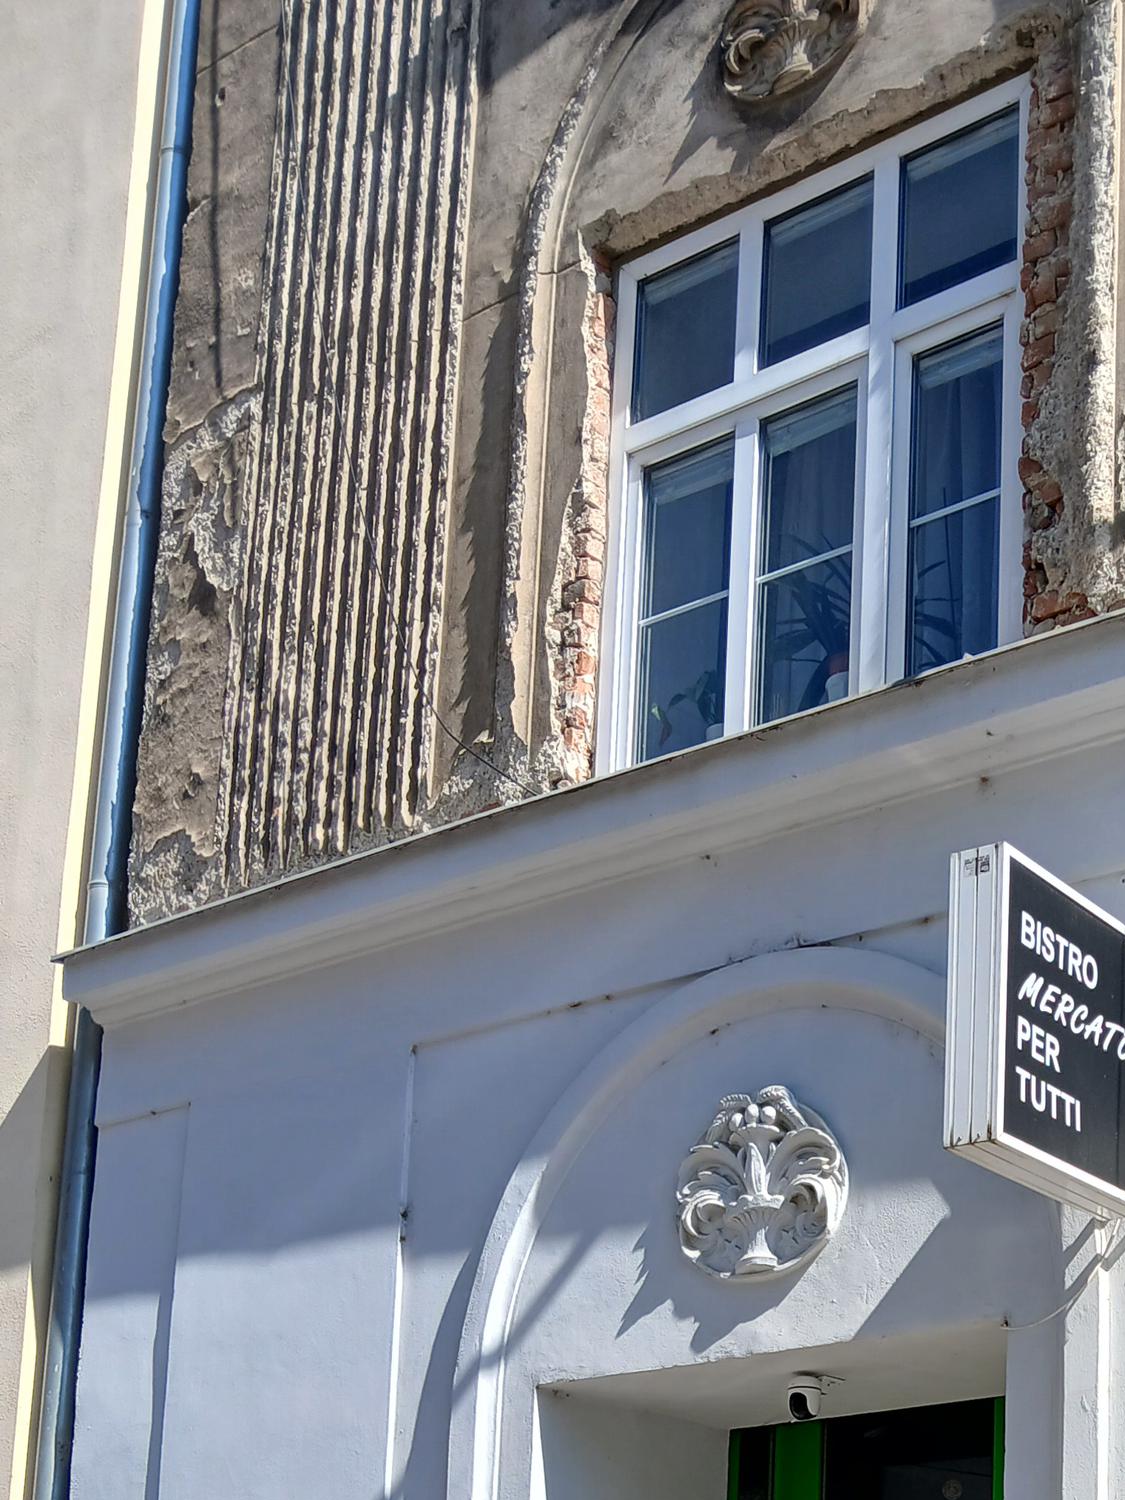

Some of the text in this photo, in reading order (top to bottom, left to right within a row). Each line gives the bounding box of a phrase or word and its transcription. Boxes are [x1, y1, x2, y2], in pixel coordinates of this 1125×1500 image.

[1020, 910, 1099, 991] BISTRO
[1016, 1015, 1062, 1073] PER
[1015, 1065, 1082, 1133] TUTTI
